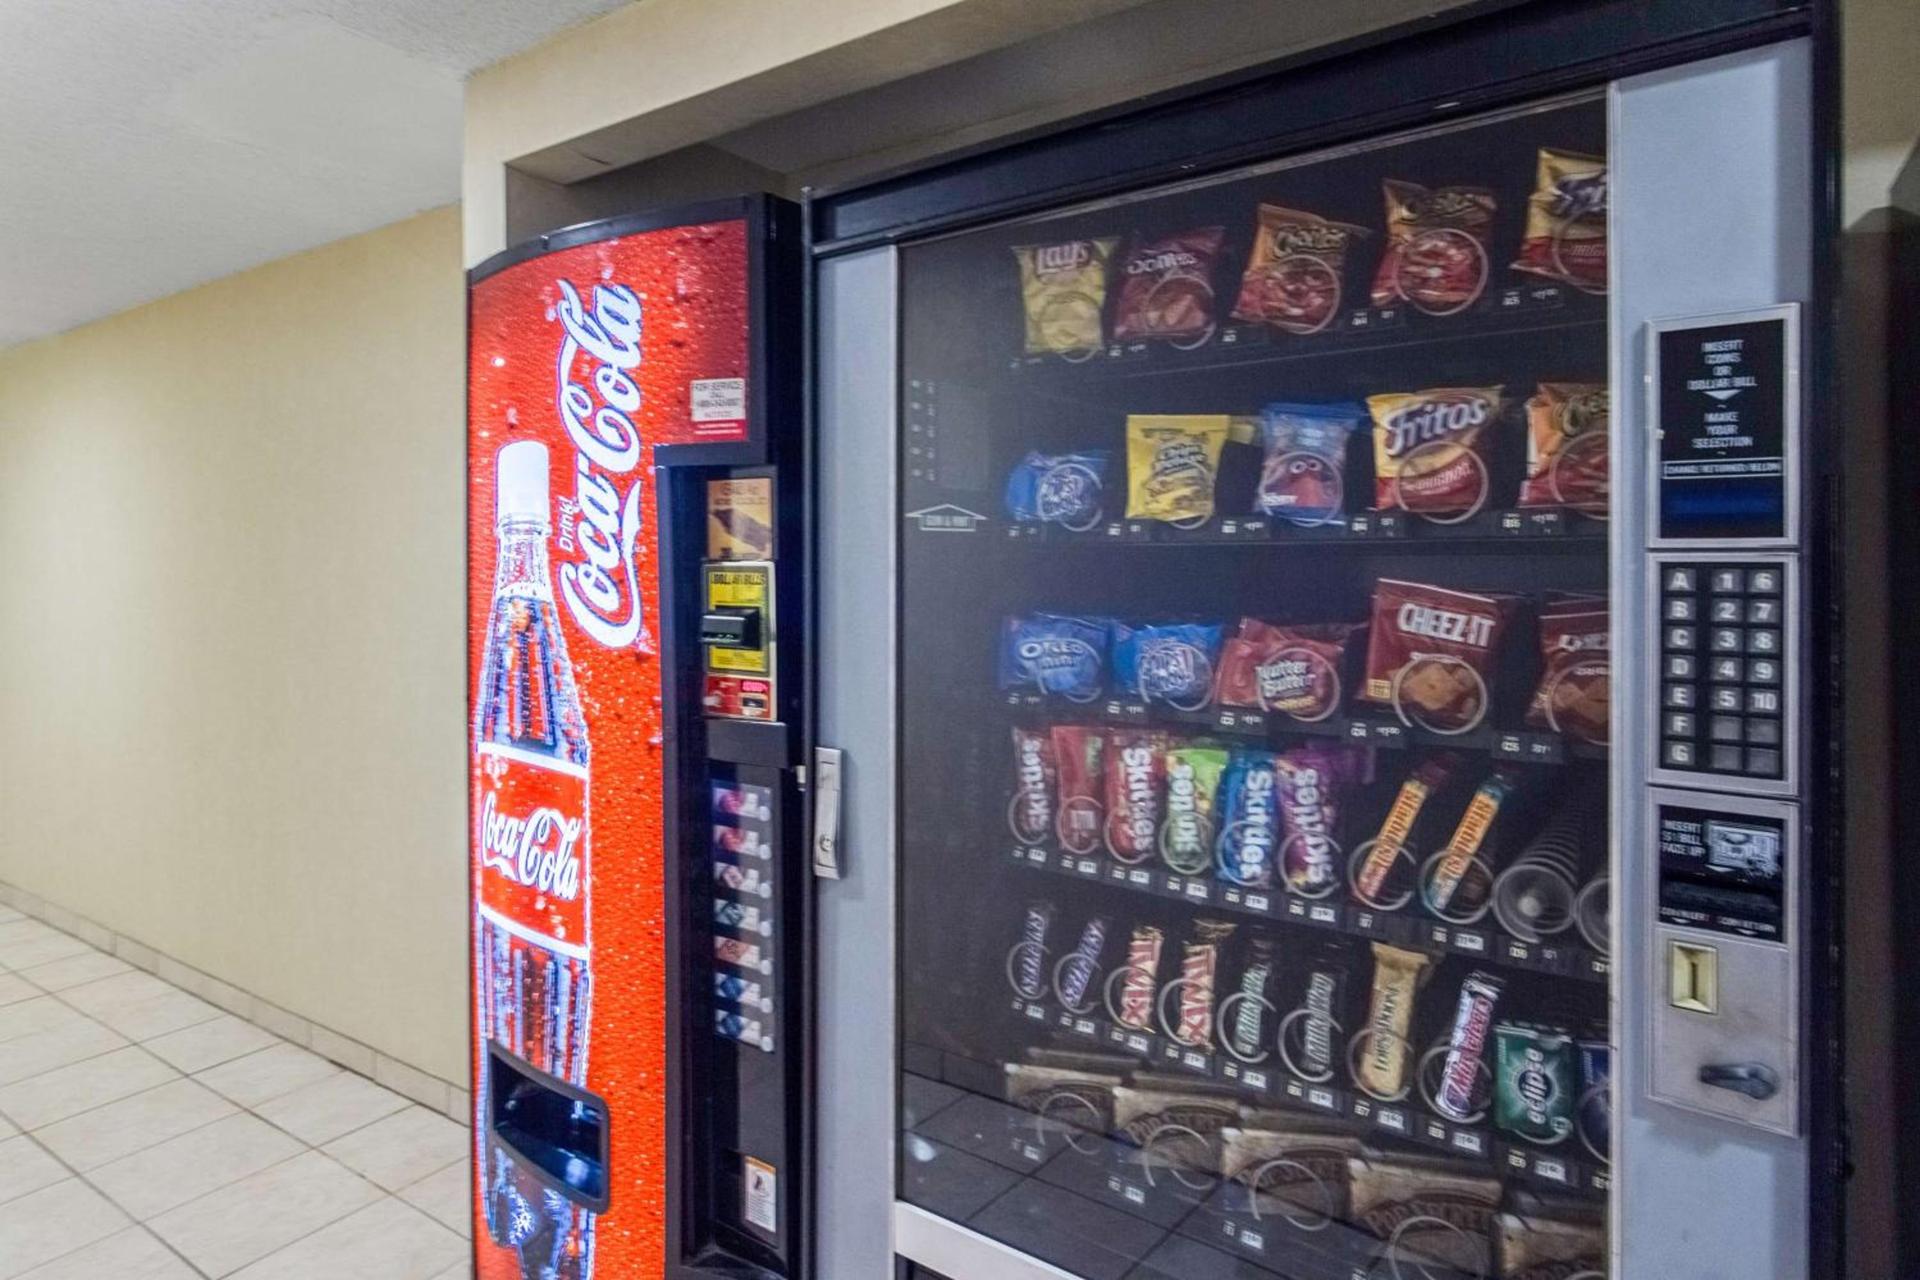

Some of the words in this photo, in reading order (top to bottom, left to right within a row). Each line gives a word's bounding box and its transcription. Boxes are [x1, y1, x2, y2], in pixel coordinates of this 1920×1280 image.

[1383, 399, 1488, 457] Fritos
[1671, 572, 1690, 590] A
[1719, 572, 1734, 590] 1
[1754, 572, 1773, 590] 6
[1671, 601, 1689, 618] B
[1719, 602, 1736, 619] 2
[1754, 602, 1772, 620] 7
[1671, 629, 1689, 647] C
[1719, 631, 1736, 648] 3
[1755, 632, 1773, 650] 8
[1671, 658, 1689, 676] D
[1719, 661, 1736, 677] 4
[1755, 662, 1773, 680] 9
[1672, 687, 1688, 705] E
[1719, 690, 1736, 708] 5
[1751, 692, 1777, 711] 10
[1672, 716, 1688, 733] F
[1671, 745, 1689, 763] G
[1122, 747, 1155, 851] Skittles
[1239, 769, 1273, 880] Skittles
[1292, 768, 1334, 883] Skittles
[482, 790, 582, 901] Coca-Cola
[1523, 1047, 1548, 1125] eclipse
